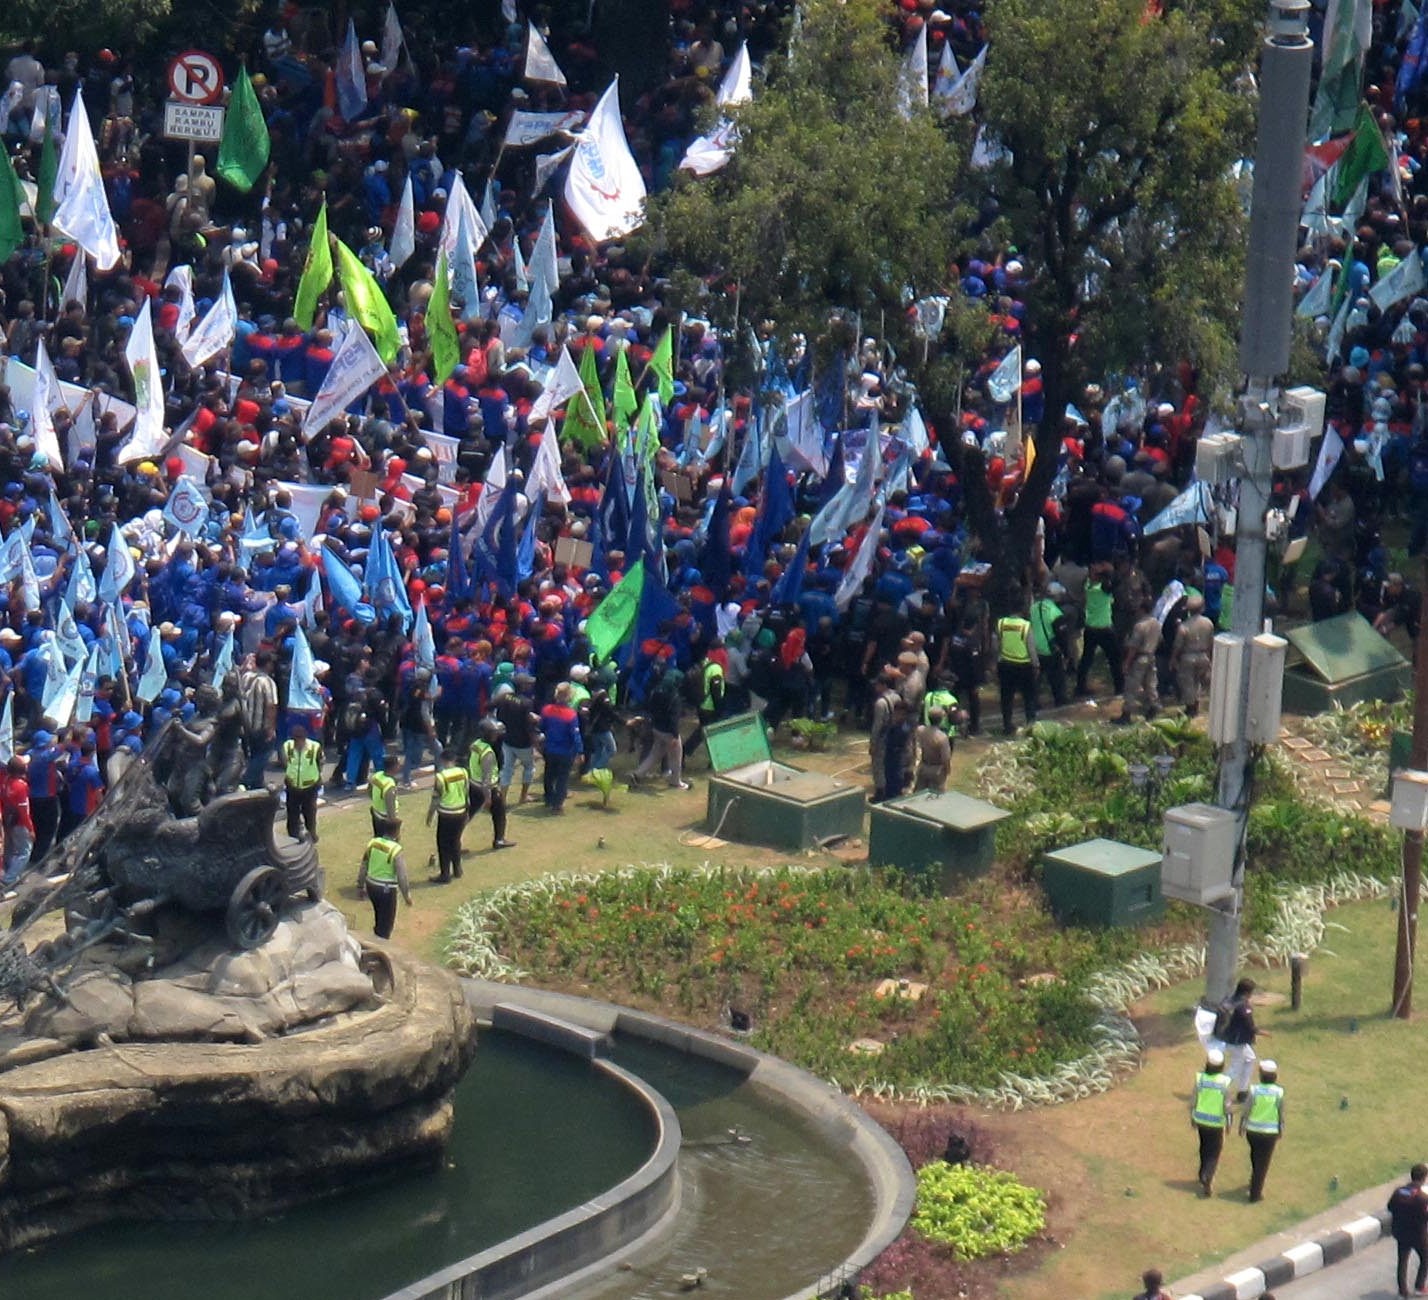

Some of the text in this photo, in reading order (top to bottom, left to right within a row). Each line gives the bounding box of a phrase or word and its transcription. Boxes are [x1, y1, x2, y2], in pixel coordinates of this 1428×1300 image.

[174, 108, 216, 120] SAMPAI
[174, 115, 215, 128] RAMBU
[170, 125, 217, 137] BERIKUT
